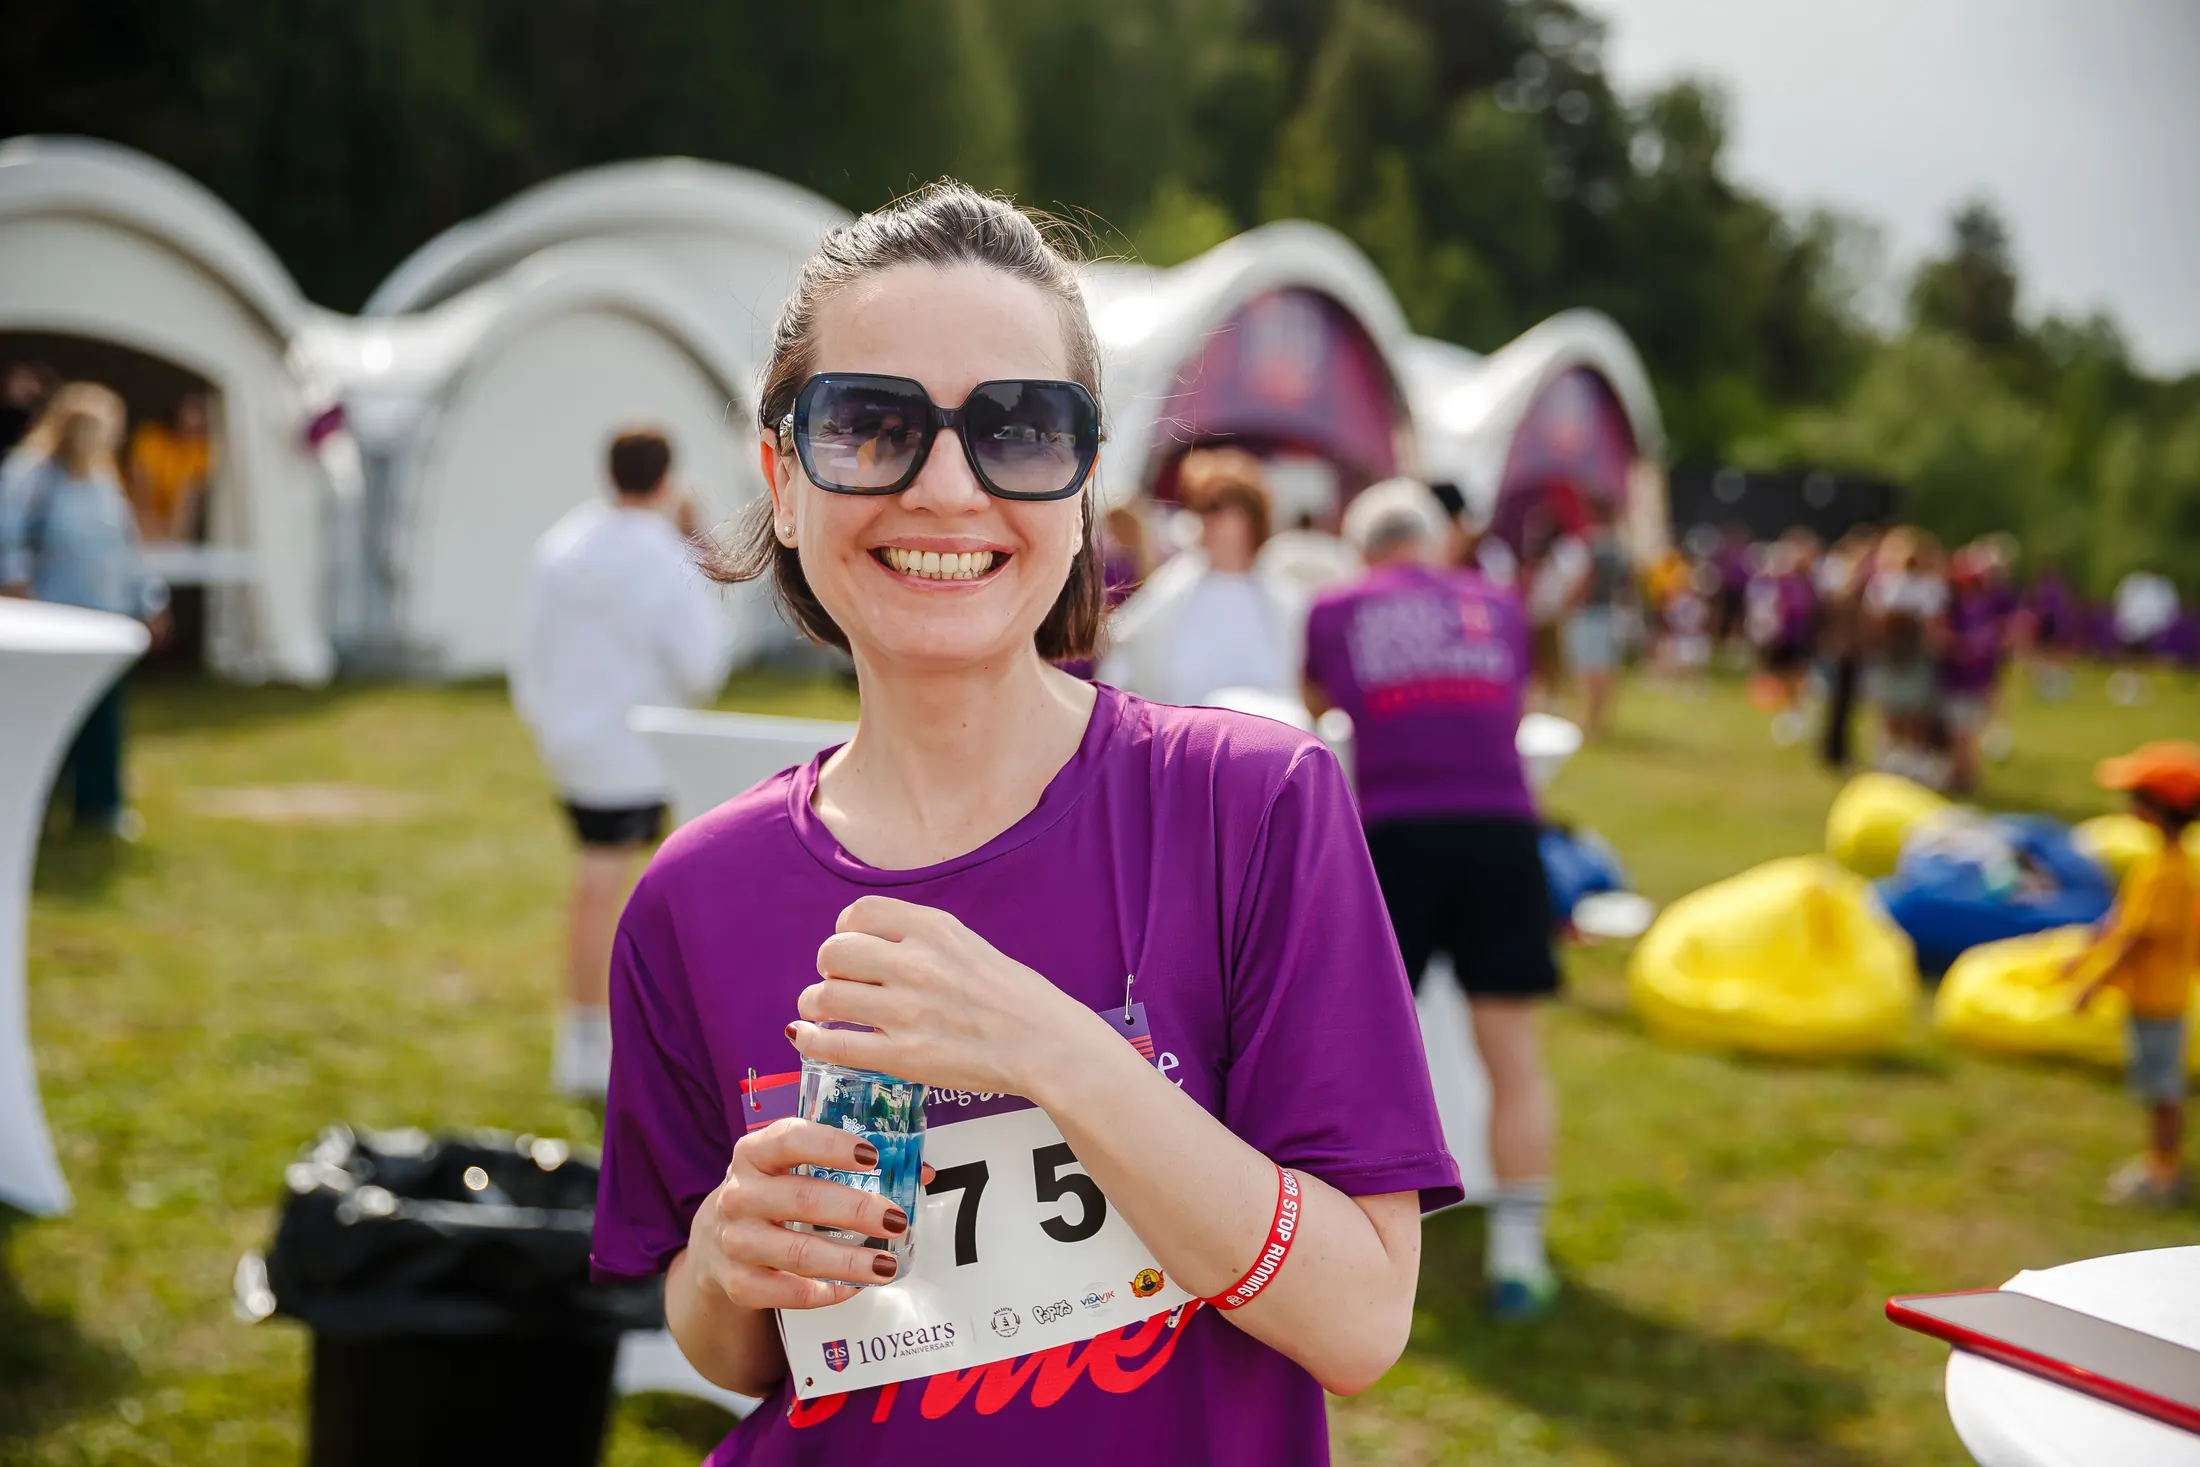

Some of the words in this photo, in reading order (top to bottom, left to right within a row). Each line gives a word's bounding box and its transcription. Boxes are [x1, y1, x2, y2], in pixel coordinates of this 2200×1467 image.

[1276, 1198, 1298, 1242] STOP
[828, 1231, 842, 1239] 330
[825, 1346, 847, 1360] CIS
[899, 1340, 955, 1357] ANNIVERSARY
